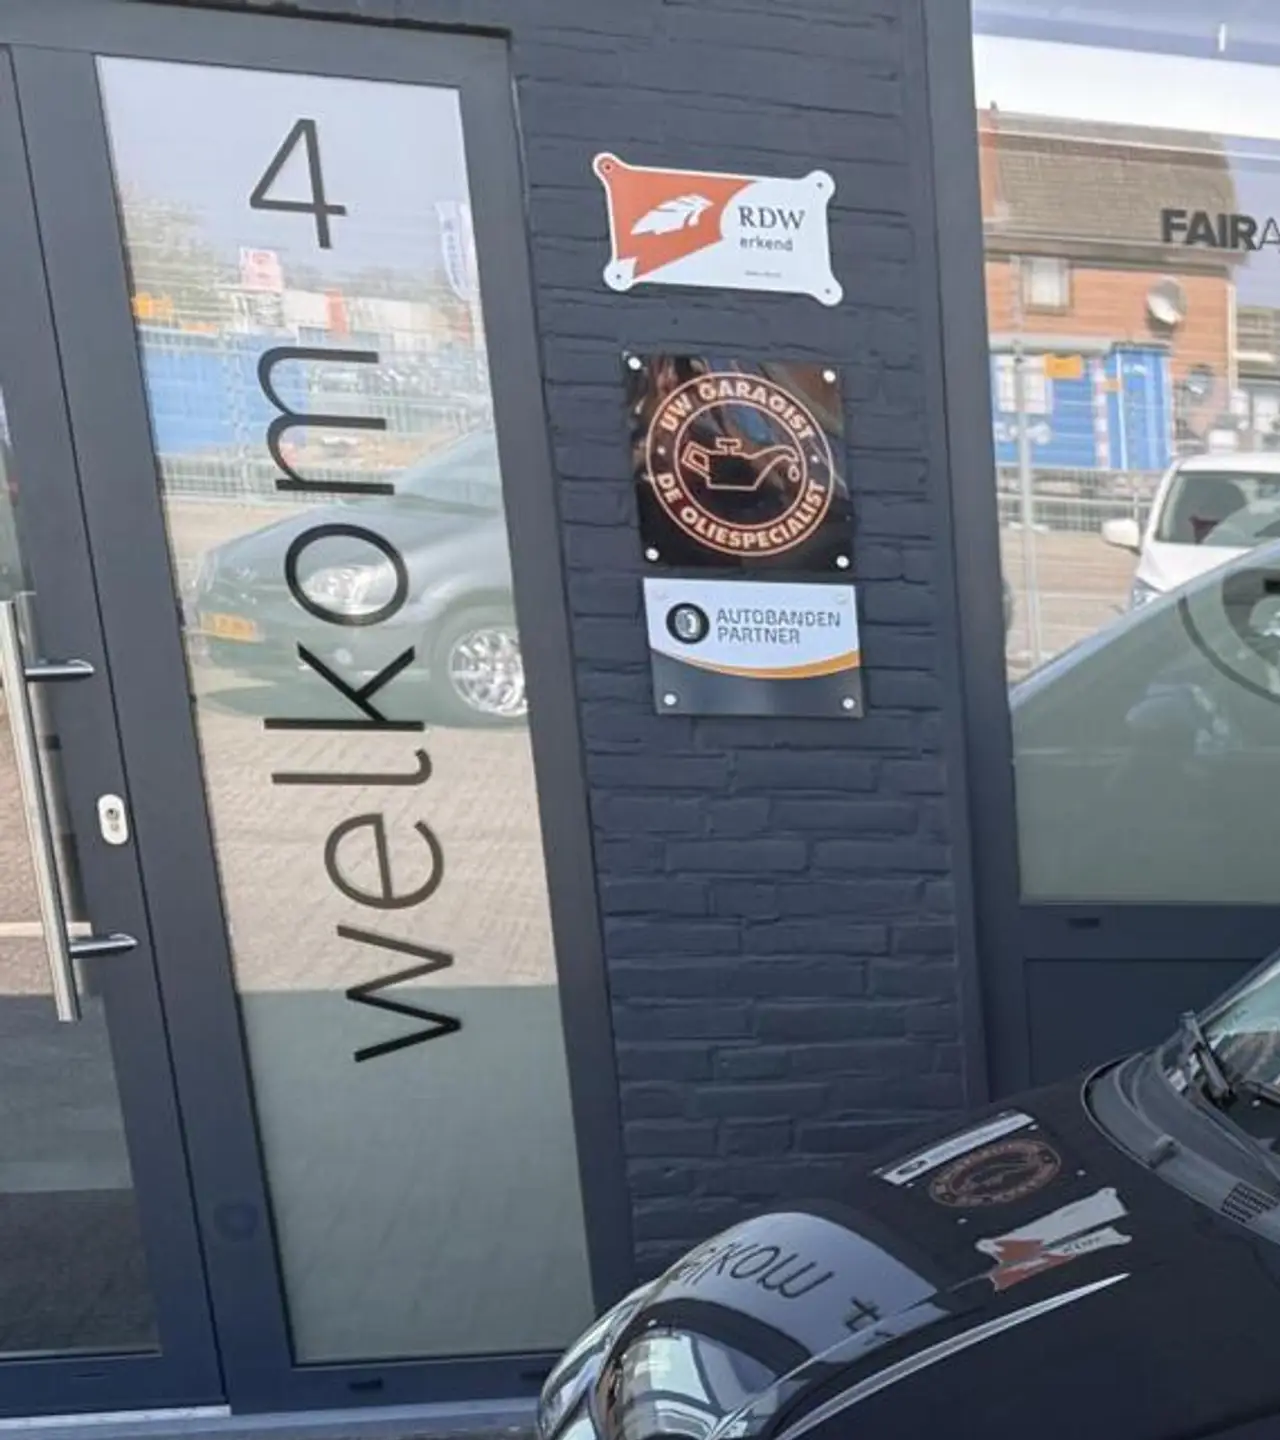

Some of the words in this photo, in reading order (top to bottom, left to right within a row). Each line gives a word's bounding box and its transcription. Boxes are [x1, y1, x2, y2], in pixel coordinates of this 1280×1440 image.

[250, 118, 347, 250] 4
[738, 206, 806, 230] RDW
[739, 235, 794, 252] erkend
[659, 393, 694, 433] UW
[699, 379, 815, 441] GARAGIST
[657, 472, 684, 504] DE
[680, 479, 826, 549] OLIESPECIALIST
[715, 608, 841, 628] AUTOBANDEN
[717, 627, 801, 645] PARTNER
[256, 346, 462, 1063] welkom
